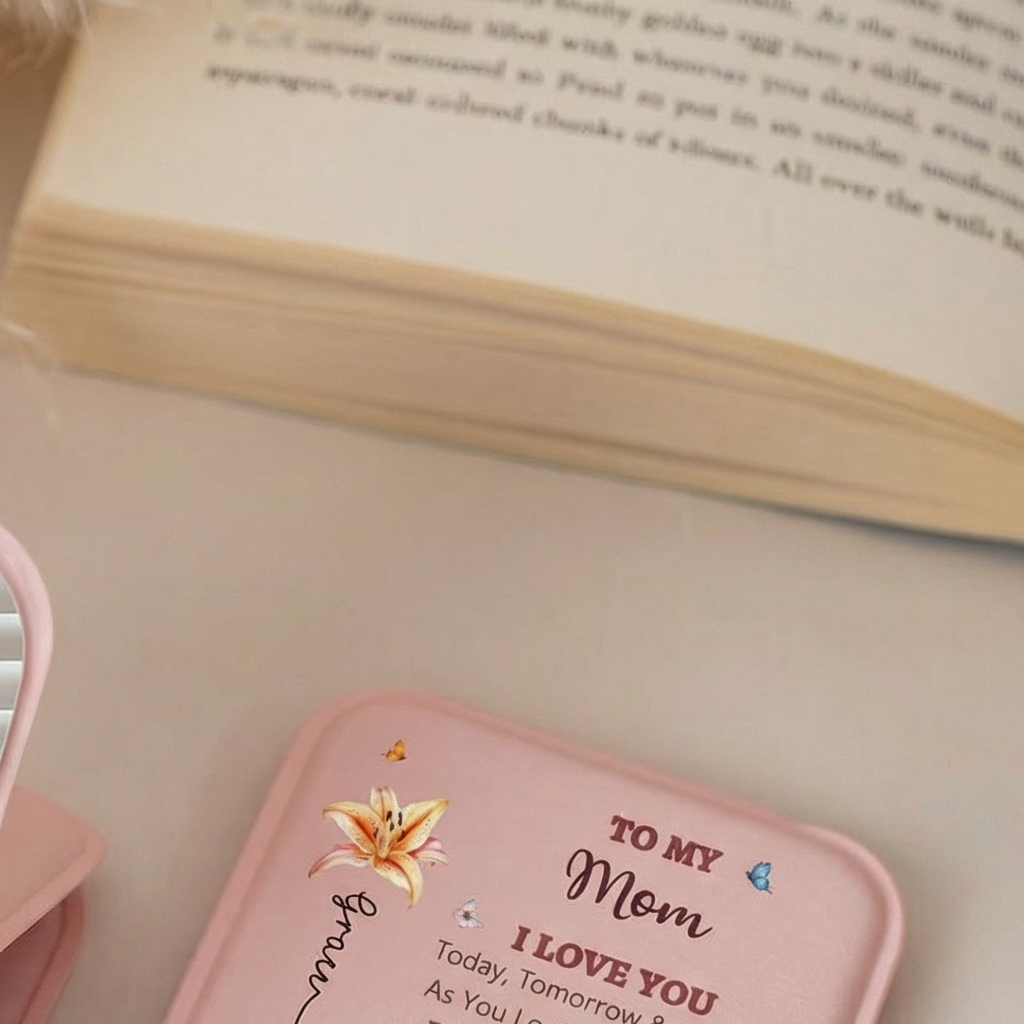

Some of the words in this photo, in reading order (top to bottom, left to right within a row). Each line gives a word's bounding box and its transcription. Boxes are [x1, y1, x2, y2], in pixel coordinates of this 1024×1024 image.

[609, 814, 658, 852] TO
[662, 834, 725, 874] MY
[566, 848, 714, 939] Mom
[436, 938, 508, 987] Today,
[510, 925, 532, 953] I
[532, 932, 633, 989] LOVE
[639, 967, 720, 1017] YOU
[423, 978, 455, 1006] As
[464, 989, 508, 1024] You
